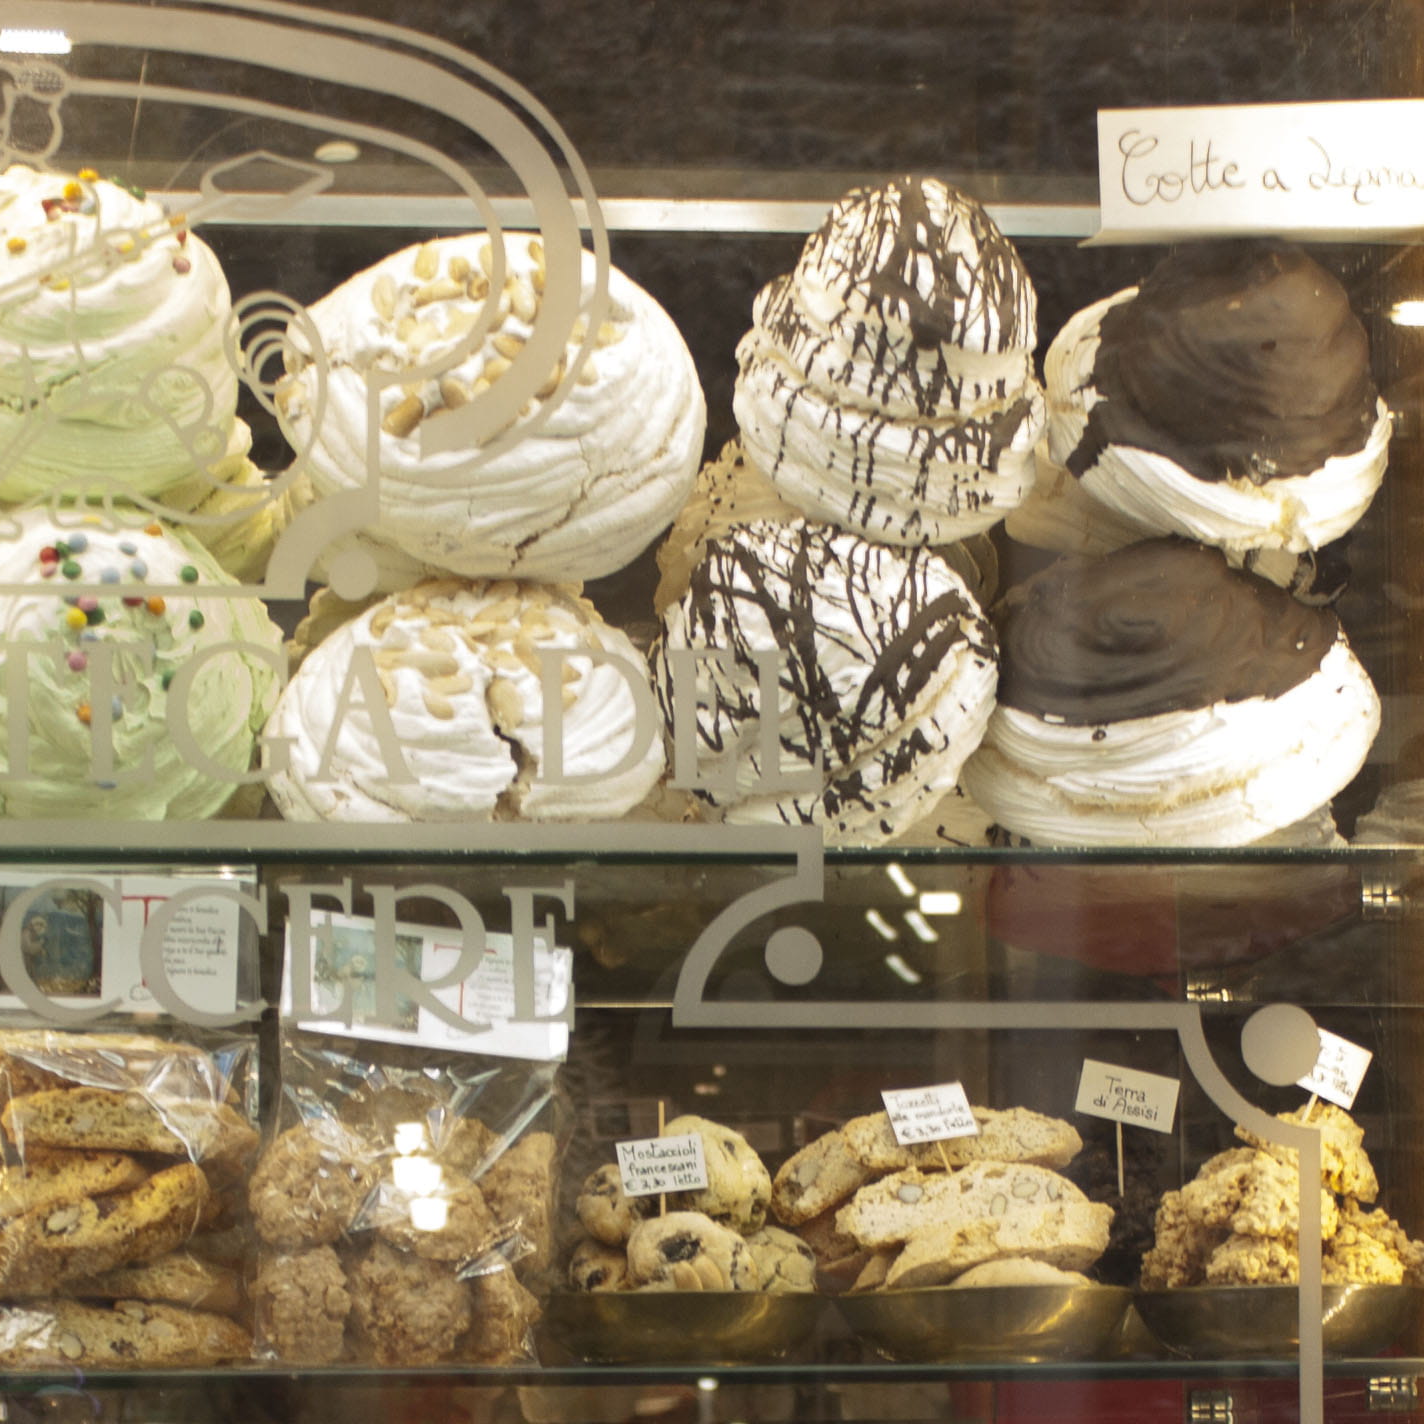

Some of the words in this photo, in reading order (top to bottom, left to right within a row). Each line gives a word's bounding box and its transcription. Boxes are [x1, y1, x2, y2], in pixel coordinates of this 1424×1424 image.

[1262, 168, 1292, 192] a
[531, 645, 824, 795] DEL
[1105, 1075, 1146, 1103] Terra
[1092, 1094, 1109, 1108] di
[1112, 1096, 1158, 1121] Assisi
[622, 1139, 697, 1161] Mostaccioli
